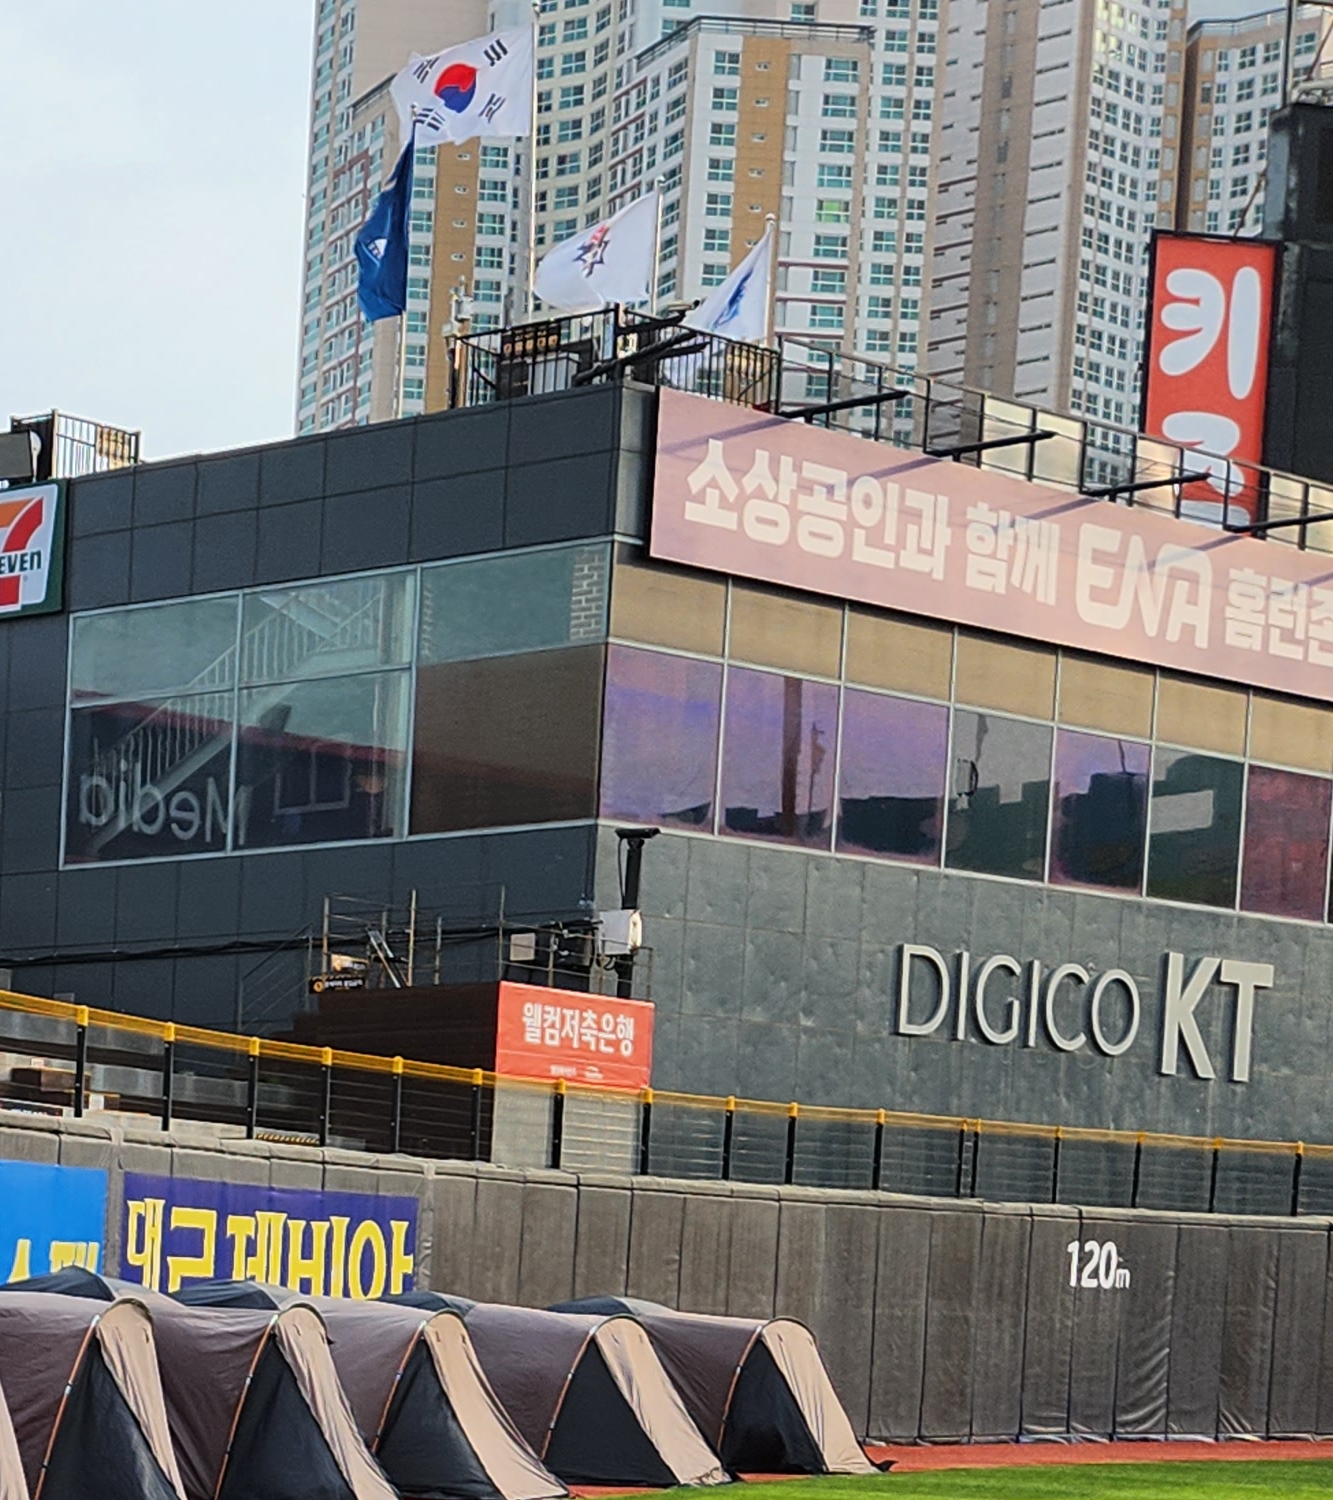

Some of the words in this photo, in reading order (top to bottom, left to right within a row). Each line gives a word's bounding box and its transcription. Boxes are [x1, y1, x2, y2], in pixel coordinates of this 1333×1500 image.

[684, 437, 953, 583] 소상공인과
[965, 501, 1059, 607] 함께
[1075, 521, 1213, 651] ENA
[521, 1001, 635, 1057] 웰컴저축은행
[897, 943, 1140, 1058] DIGICO
[1159, 951, 1274, 1084] KT
[1067, 1240, 1130, 1289] 120m
